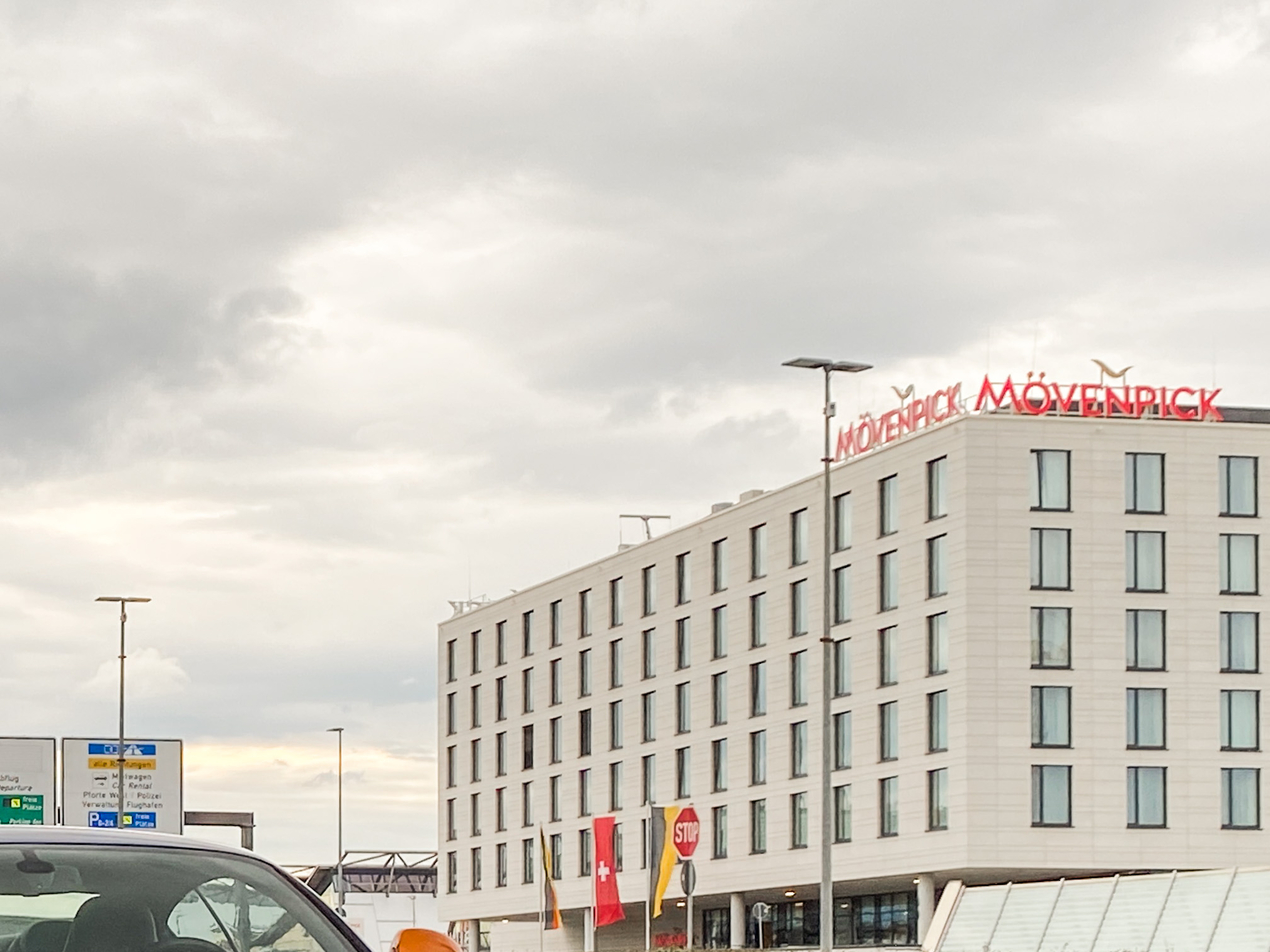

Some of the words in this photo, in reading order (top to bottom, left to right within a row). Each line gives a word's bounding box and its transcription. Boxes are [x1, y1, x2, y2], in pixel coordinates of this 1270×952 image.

[974, 371, 1225, 422] MÖVENPICK
[835, 381, 962, 462] MÖVENPICK
[129, 782, 152, 790] Rental
[127, 801, 163, 810] Flughafen
[89, 812, 99, 826] P
[675, 821, 699, 843] STOP
